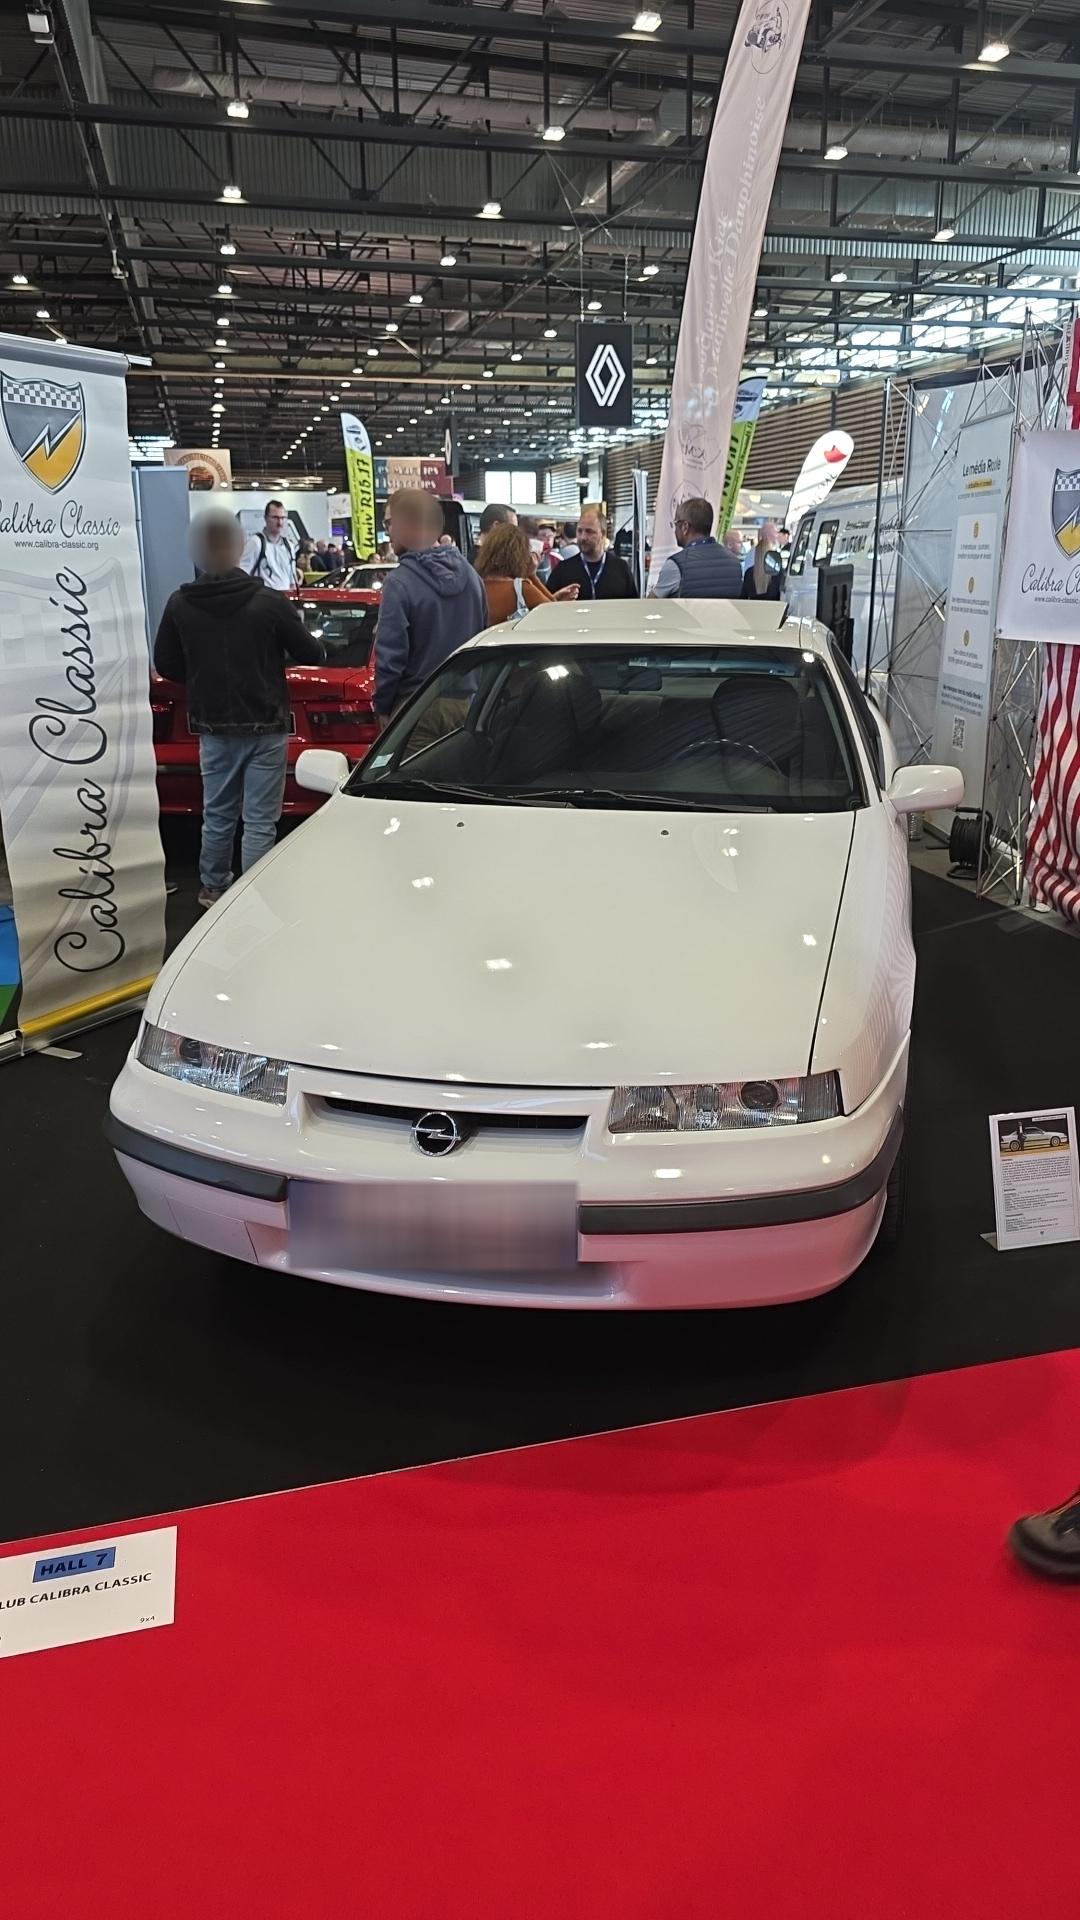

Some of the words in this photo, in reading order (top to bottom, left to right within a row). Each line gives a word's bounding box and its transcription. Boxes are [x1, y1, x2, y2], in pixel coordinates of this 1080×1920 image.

[720, 95, 768, 262] Dauphinoise
[0, 501, 57, 534] alibra
[60, 500, 121, 538] Classic
[14, 540, 99, 551] www.calibra-classic.org
[1021, 563, 1064, 593] Calibra
[28, 565, 109, 765] Classic
[54, 777, 126, 973] Calibra
[40, 1558, 88, 1576] HALL
[95, 1552, 108, 1566] 7
[0, 1597, 26, 1610] LUB
[30, 1585, 91, 1604] CALIBRA
[94, 1572, 153, 1591] CLASSIC
